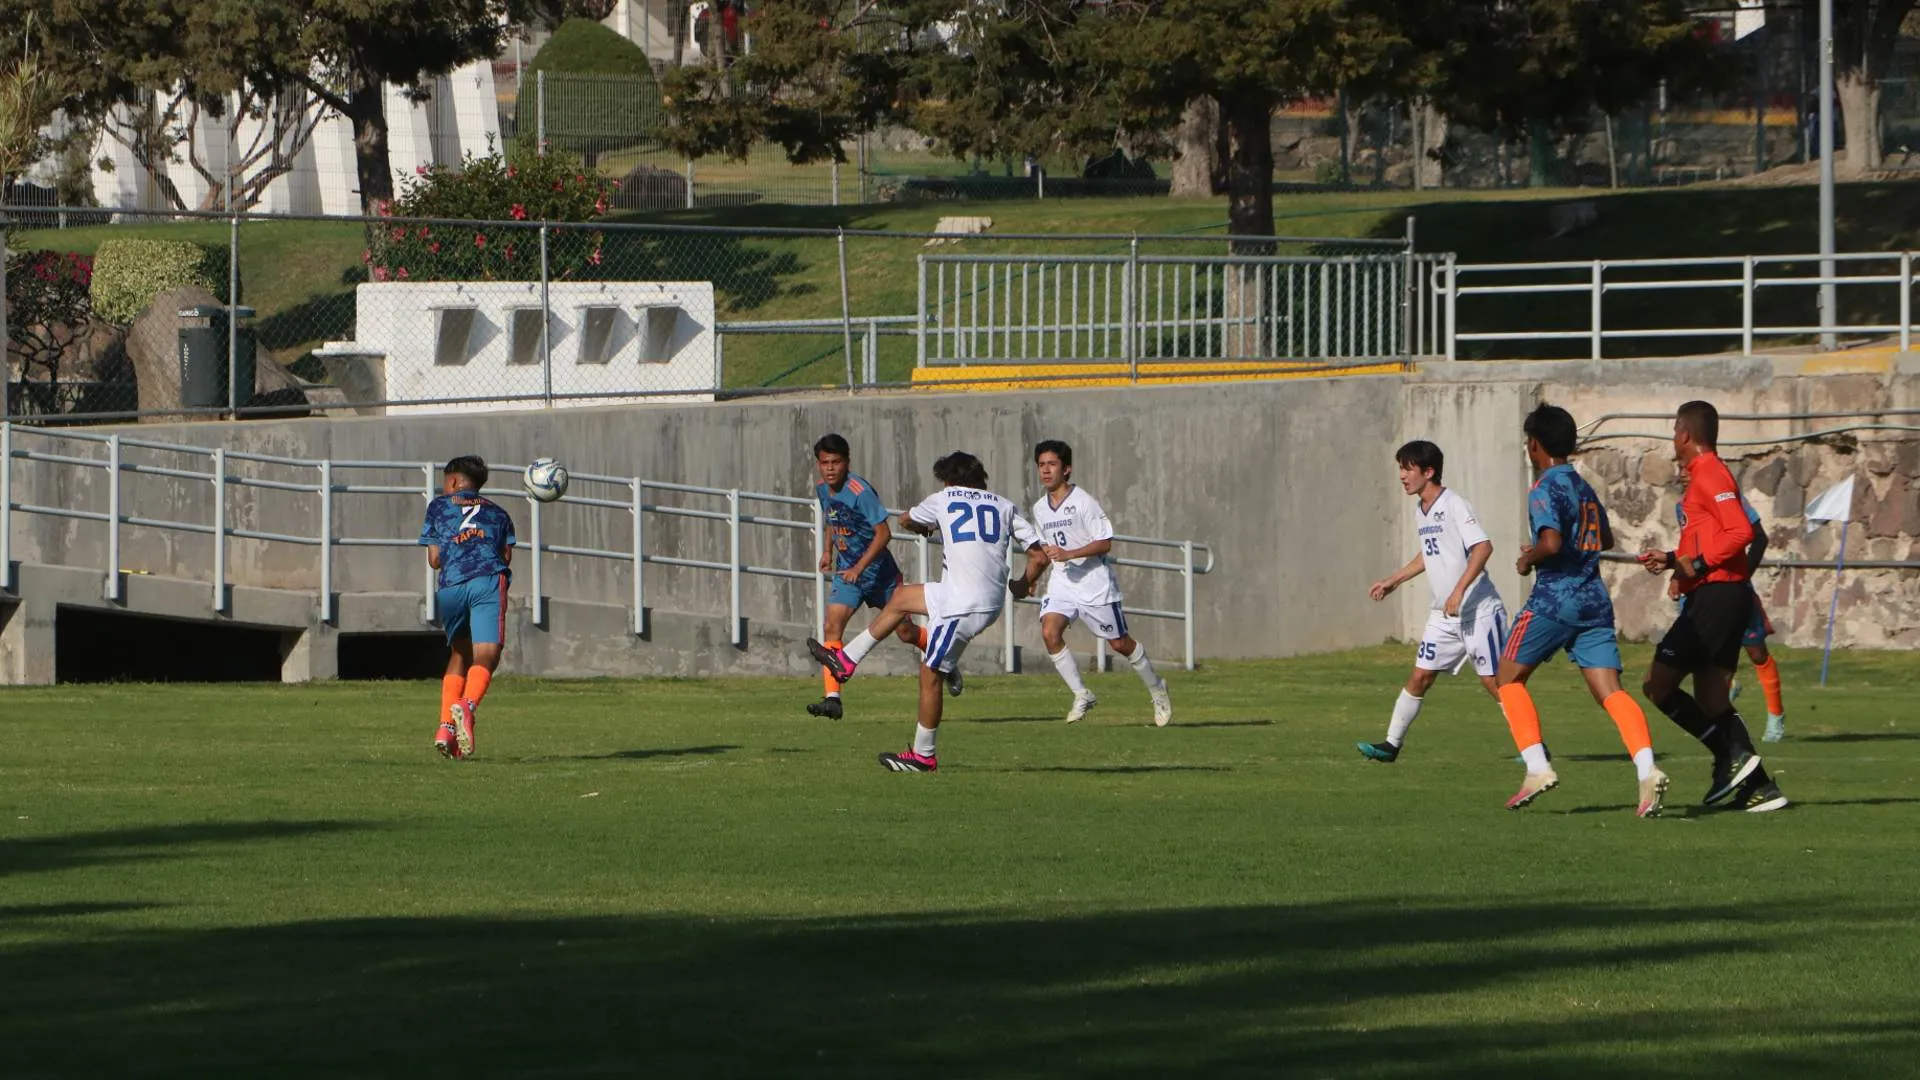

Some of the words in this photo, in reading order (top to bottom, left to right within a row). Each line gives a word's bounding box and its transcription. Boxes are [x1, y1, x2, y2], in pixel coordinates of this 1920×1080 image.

[947, 490, 963, 498] TEC
[459, 504, 481, 532] 2
[947, 501, 1001, 544] 20
[452, 528, 486, 545] TAPIA
[1053, 531, 1067, 547] 13
[1425, 537, 1440, 556] 35
[1418, 641, 1437, 661] 35
